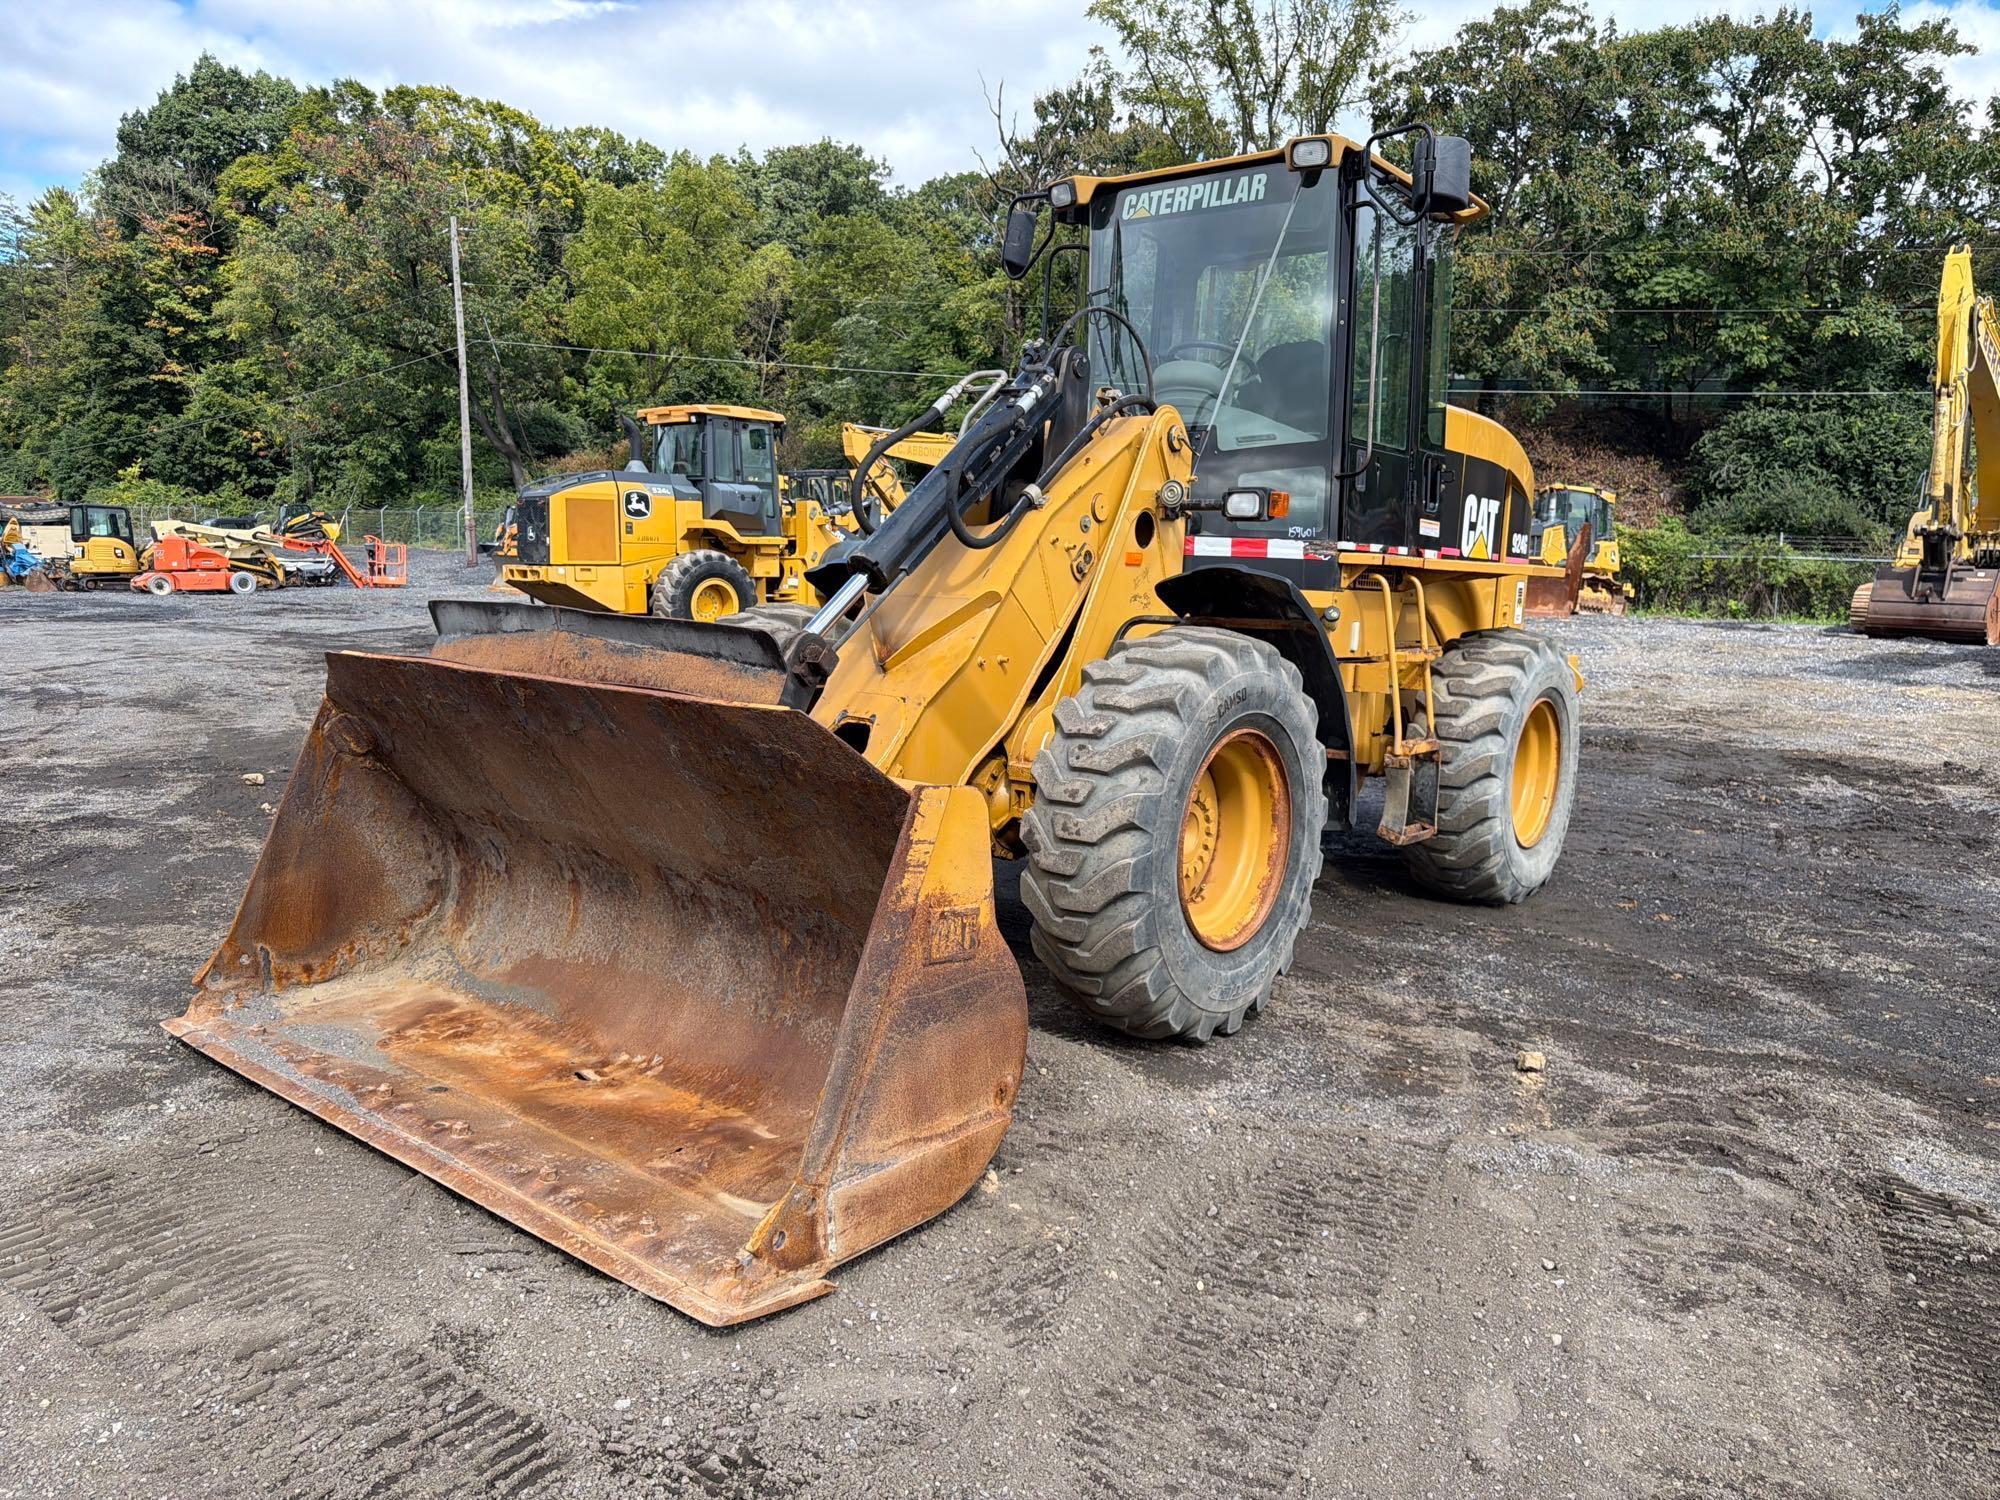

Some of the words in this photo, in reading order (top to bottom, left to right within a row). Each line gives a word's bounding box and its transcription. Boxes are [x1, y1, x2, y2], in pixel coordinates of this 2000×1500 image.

[1121, 173, 1268, 221] CATERPILLAR
[1288, 526, 1316, 538] 159601
[1461, 494, 1500, 560] CAT
[1217, 687, 1247, 718] CAMSO
